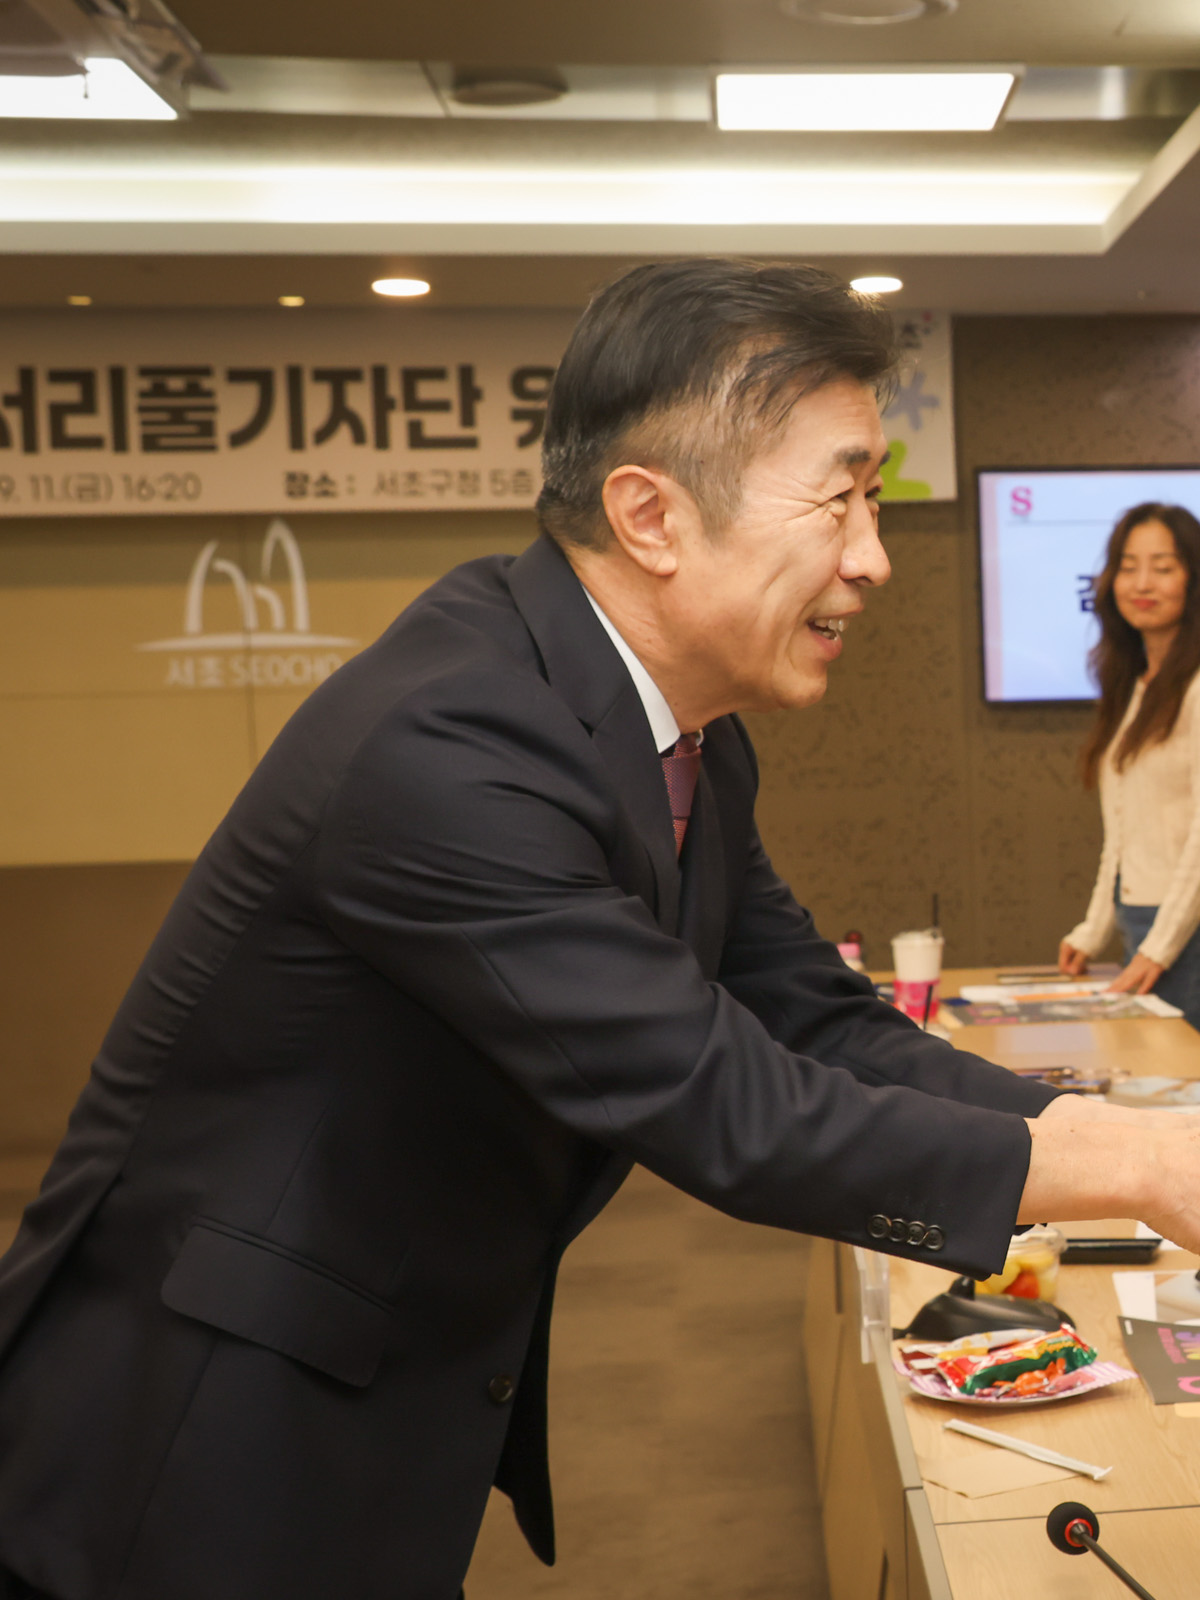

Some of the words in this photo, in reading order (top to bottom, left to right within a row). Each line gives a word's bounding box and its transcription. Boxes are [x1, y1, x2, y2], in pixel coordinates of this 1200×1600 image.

[0, 364, 482, 454] 서리풀기자단
[489, 468, 534, 497] 5층
[1011, 486, 1033, 516] S
[164, 656, 224, 687] 서초
